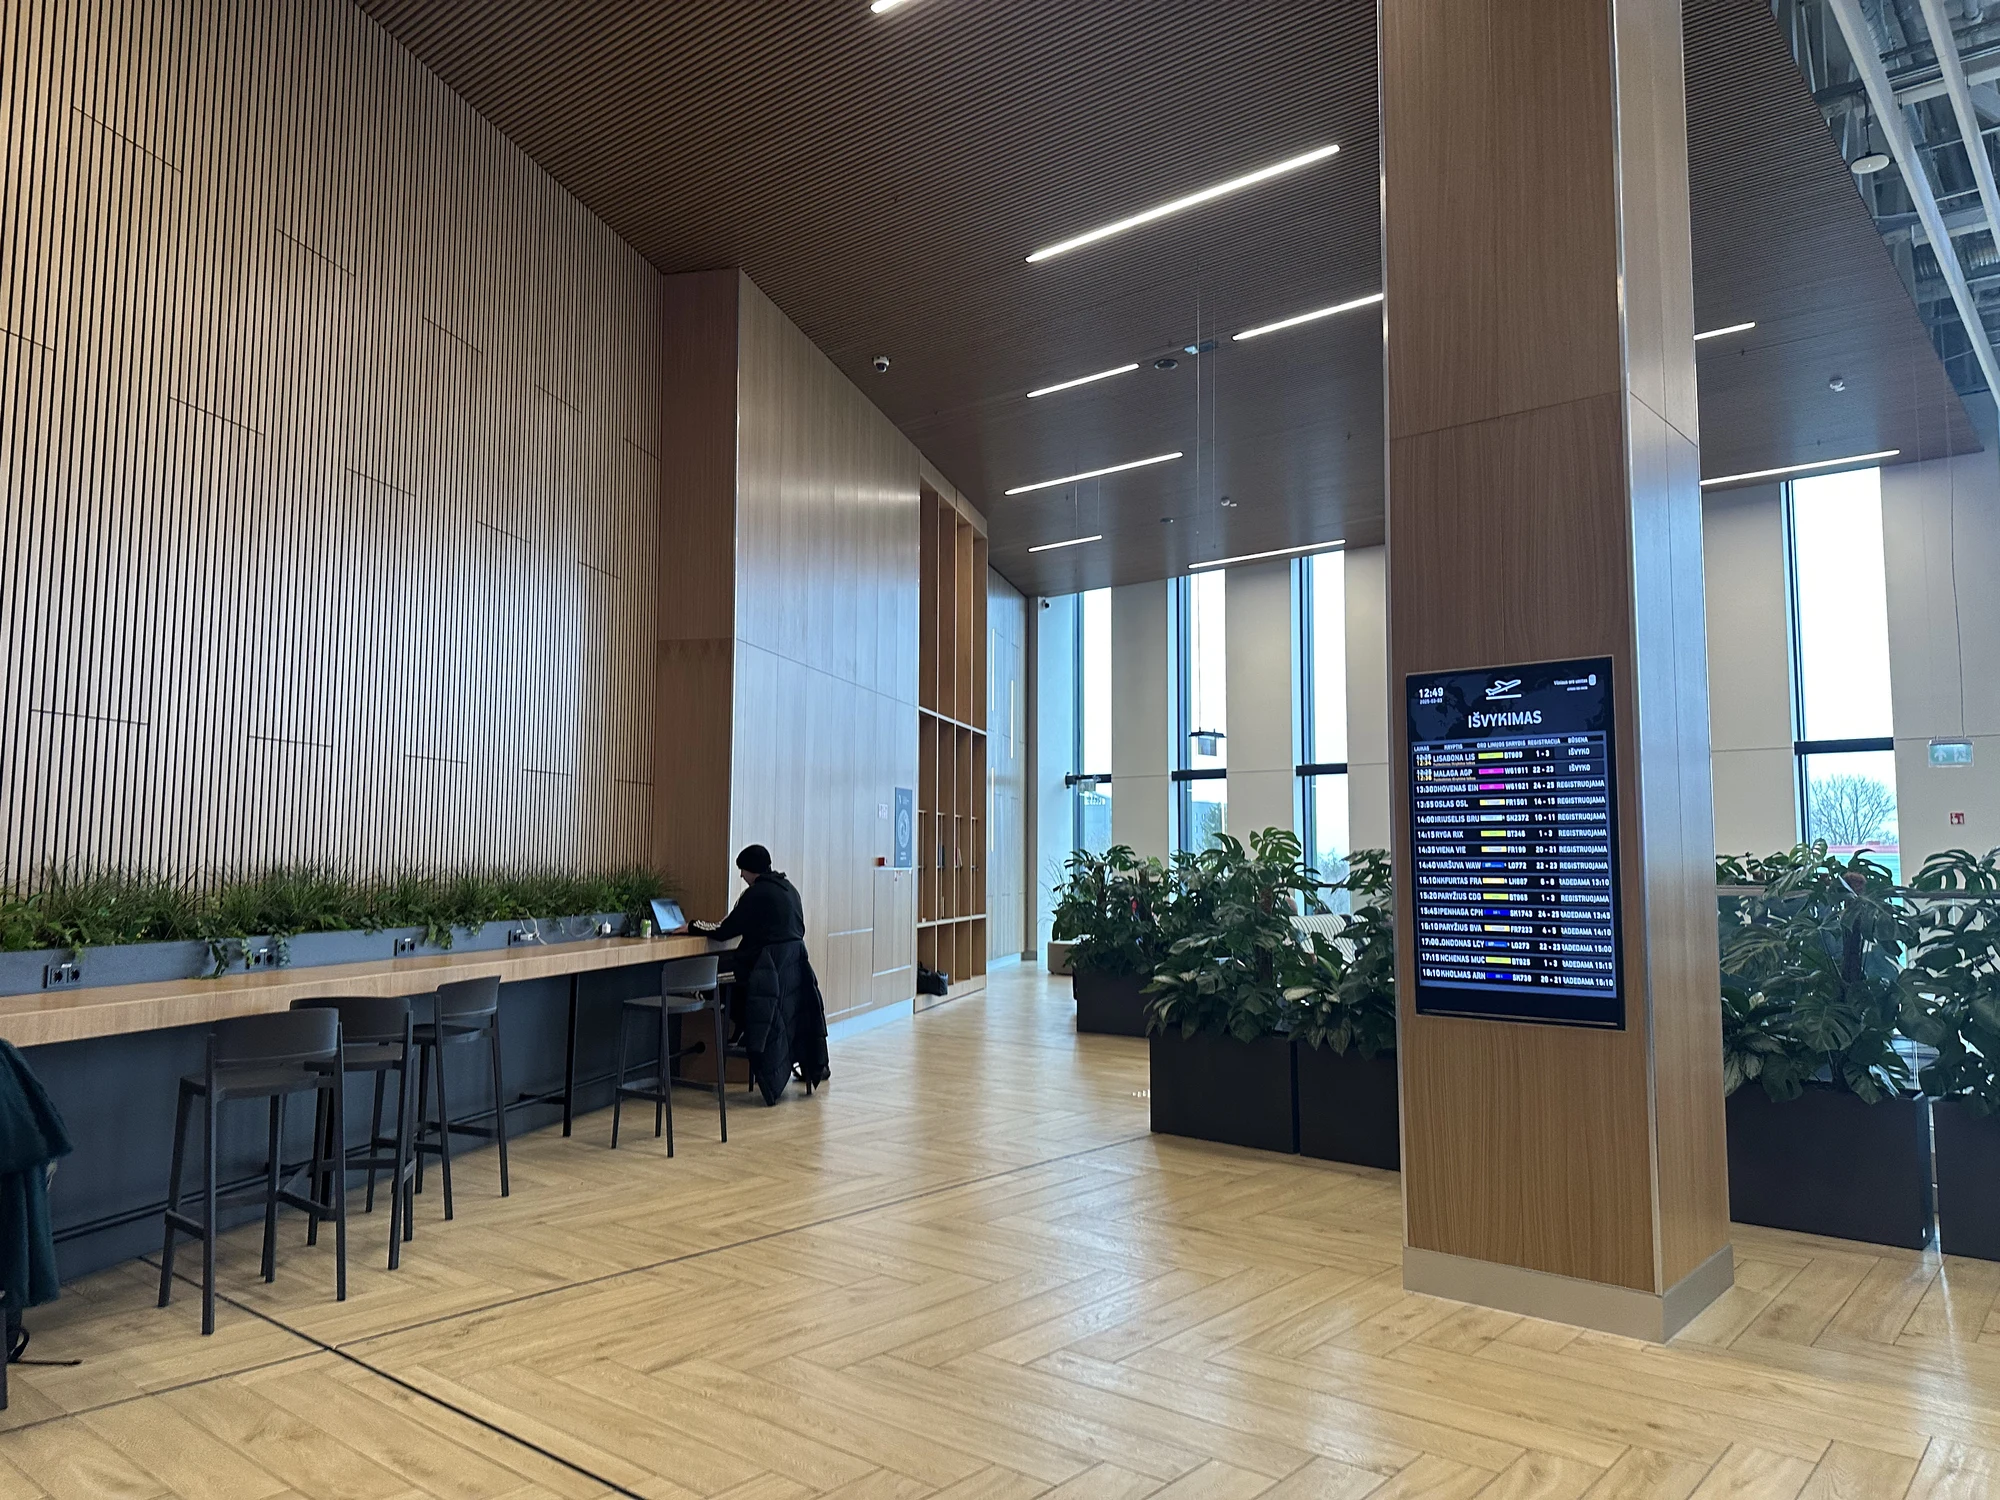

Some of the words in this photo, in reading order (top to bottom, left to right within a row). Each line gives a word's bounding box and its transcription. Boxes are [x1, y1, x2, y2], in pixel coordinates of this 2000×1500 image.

[1419, 687, 1443, 698] 12:49
[1468, 711, 1542, 728] IŠVYKIMAS
[1568, 747, 1590, 755] IŠVYKO
[1569, 764, 1590, 772] IŠVYKO
[1557, 780, 1604, 788] REGISTRUOJAMA
[1557, 796, 1605, 804] REGISTRUOJAMA
[1559, 829, 1606, 837] REGISTRUOJAMA
[1559, 845, 1607, 853] REGISTRUOJAMA
[1419, 861, 1436, 869] 14:40
[1437, 860, 1464, 869] VARŠUVA
[1560, 862, 1607, 870] REGISTRUOJAMA
[1438, 891, 1467, 900] PARYŽIUS
[1469, 893, 1481, 901] CDG
[1561, 895, 1609, 903] REGISTRUOJAMA
[1439, 922, 1468, 931] PARYŽIUS
[1470, 924, 1482, 932] BVA
[1594, 928, 1611, 936] 14:10
[1440, 938, 1471, 947] ONDONAS
[1473, 940, 1484, 948] LCY
[1595, 944, 1612, 952] 15:00
[1422, 953, 1439, 961] 17:15
[1473, 971, 1485, 979] ARN
